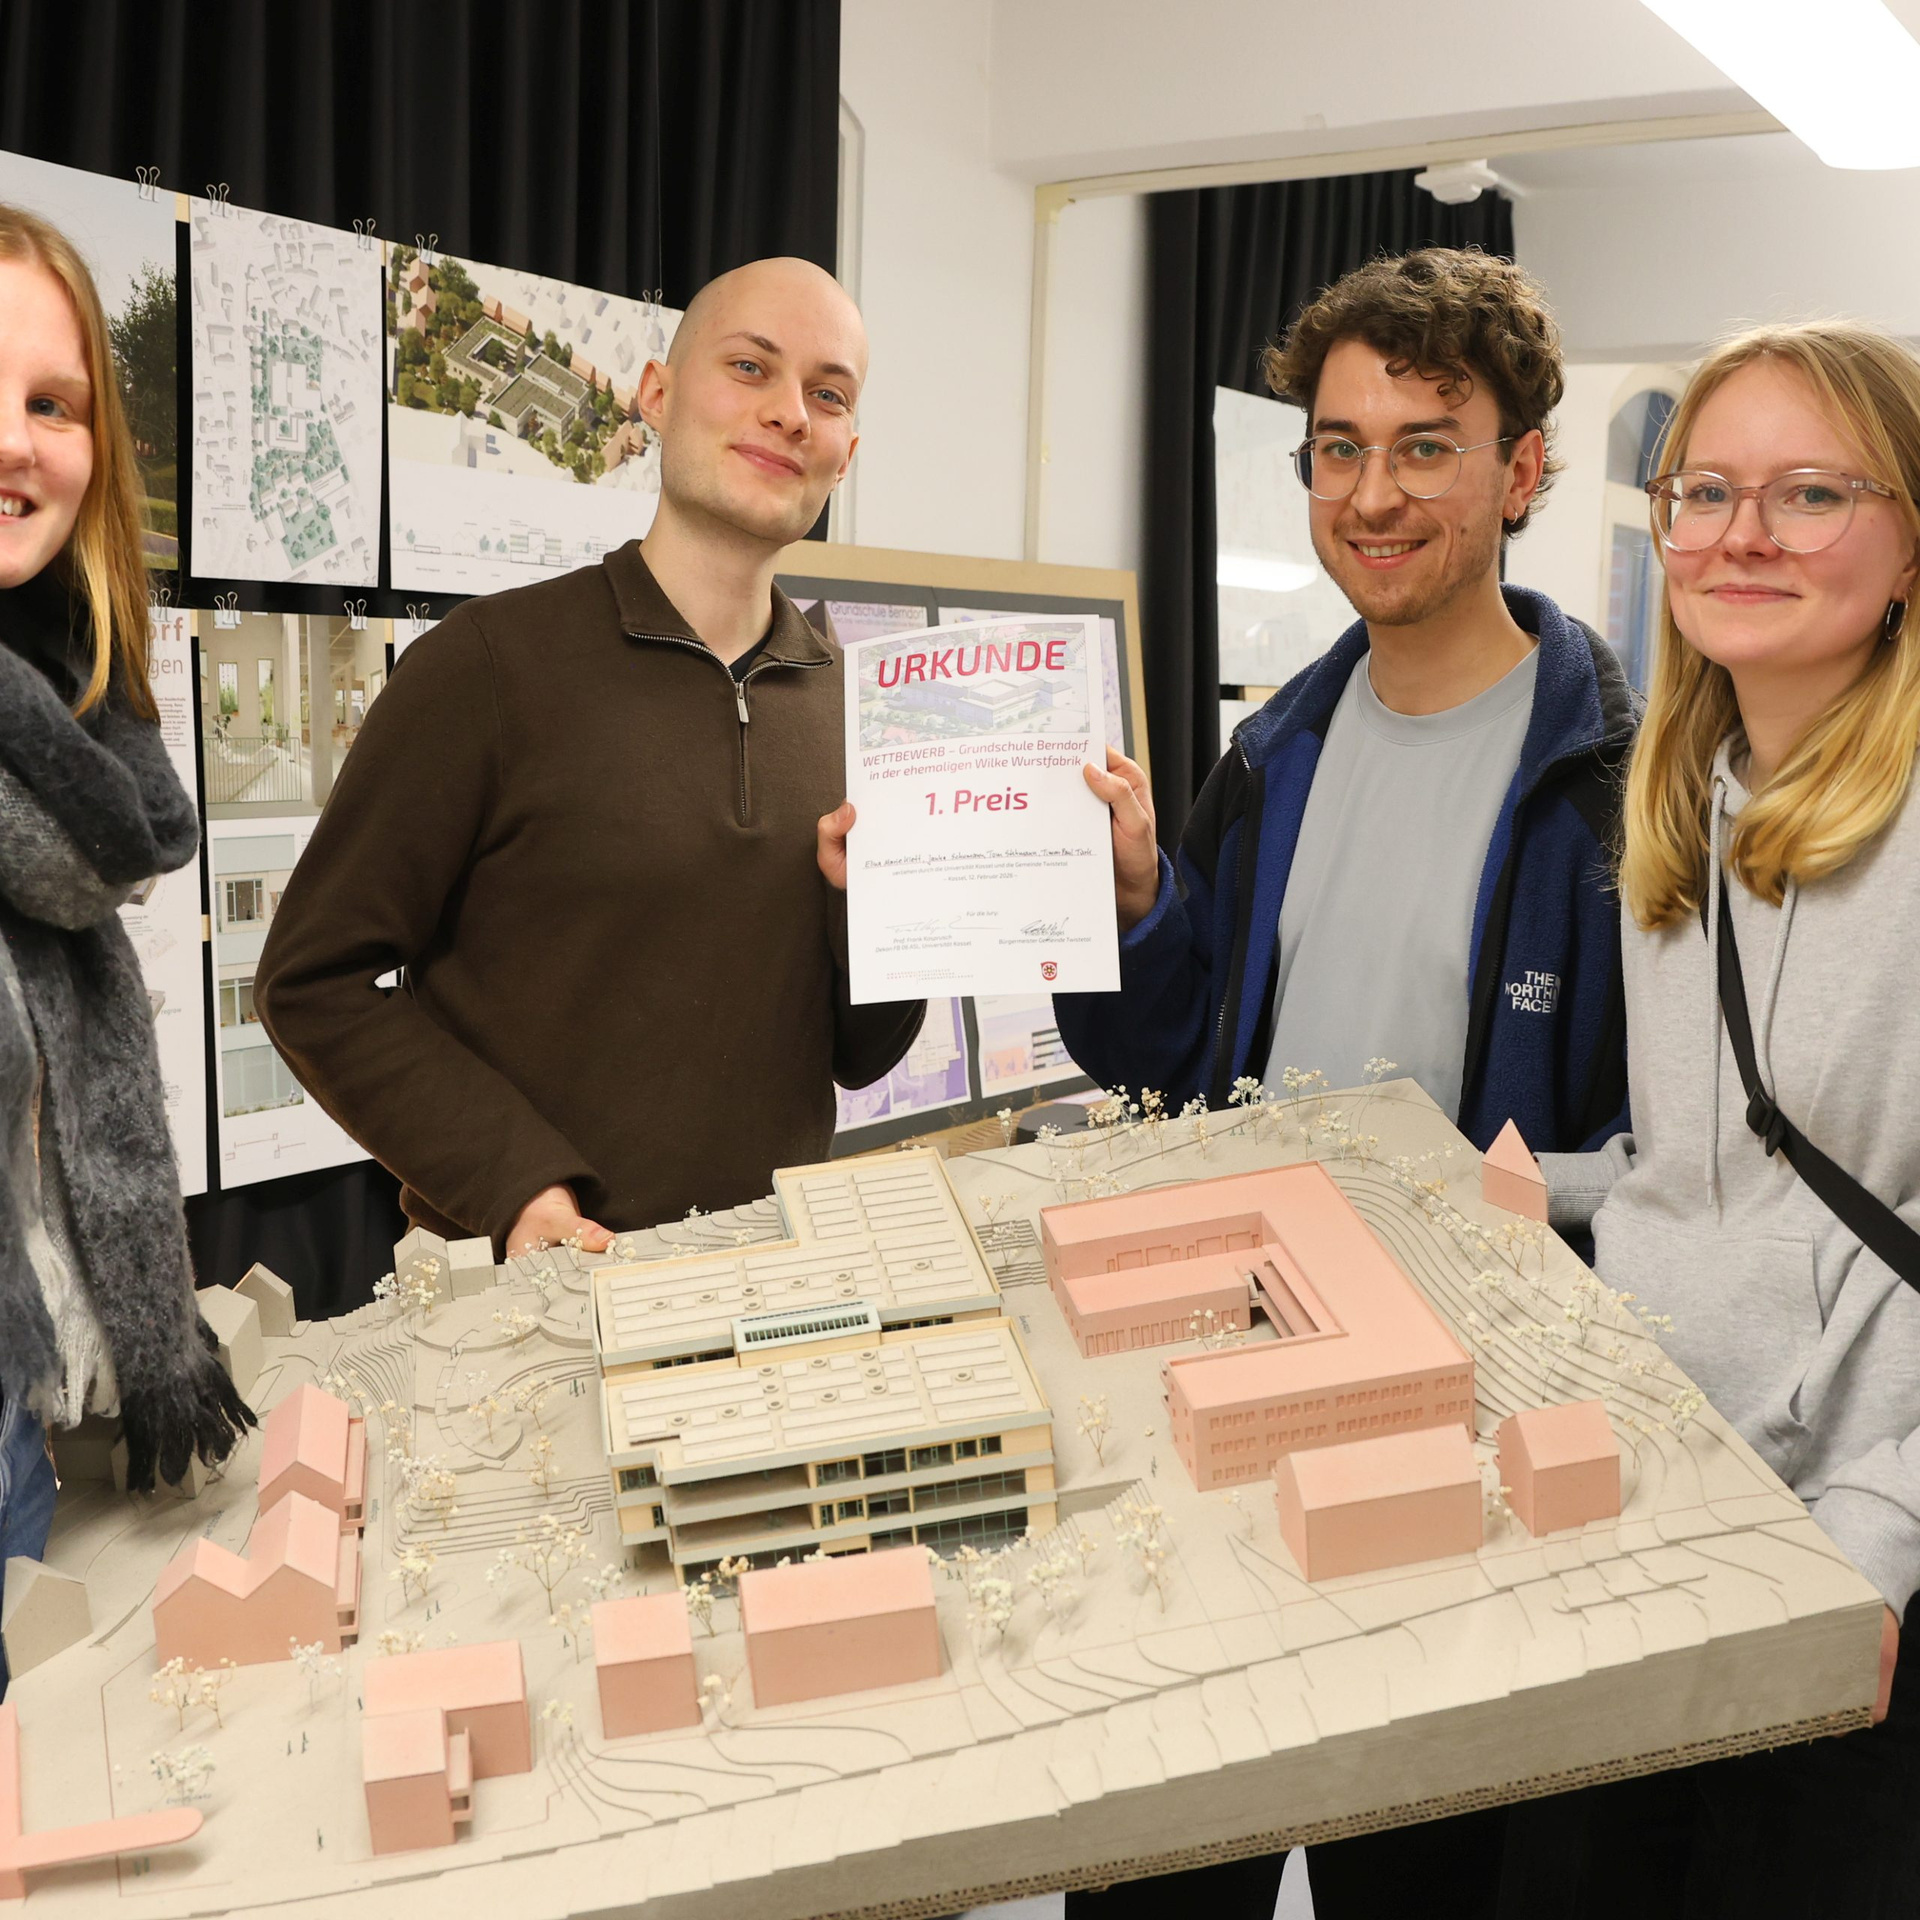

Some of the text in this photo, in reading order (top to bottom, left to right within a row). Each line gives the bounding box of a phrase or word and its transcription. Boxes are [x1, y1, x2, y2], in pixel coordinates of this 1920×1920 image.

[877, 640, 1067, 688] URKUNDE
[863, 746, 946, 767] WETTBEWERB
[959, 740, 1034, 755] Grundschule
[1036, 739, 1089, 753] Berndorf
[869, 755, 1082, 781] in der ehemaligen Wilke Wurstfabrik
[924, 787, 1029, 816] 1. Preis
[944, 864, 975, 872] Universität
[1525, 970, 1555, 986] THE
[1512, 997, 1552, 1013] FACE
